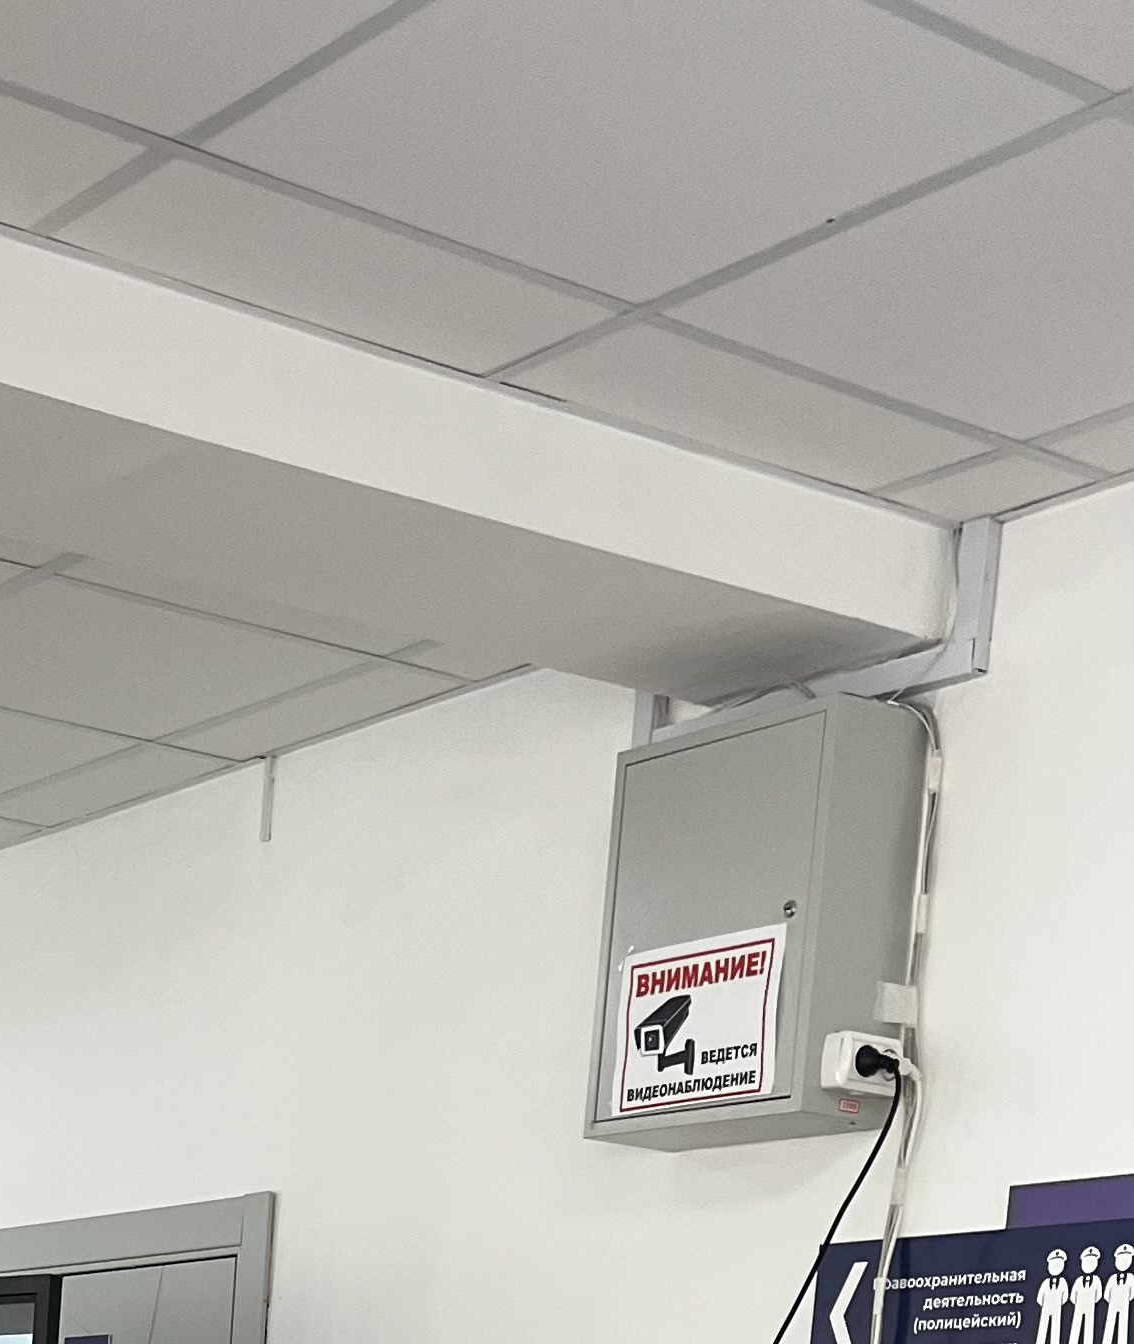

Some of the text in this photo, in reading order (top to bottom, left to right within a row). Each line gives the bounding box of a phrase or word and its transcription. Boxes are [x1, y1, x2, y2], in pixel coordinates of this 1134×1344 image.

[635, 950, 767, 998] ВНИМАНИЕ!
[700, 1042, 758, 1065] ВЕДЕТСЯ
[626, 1069, 757, 1103] ВИДЕОНАБЛЮДЕНИЕ
[873, 1269, 1027, 1291] равоохранительная
[922, 1292, 1025, 1312] деятельность
[913, 1311, 1022, 1334] (полицейский)
